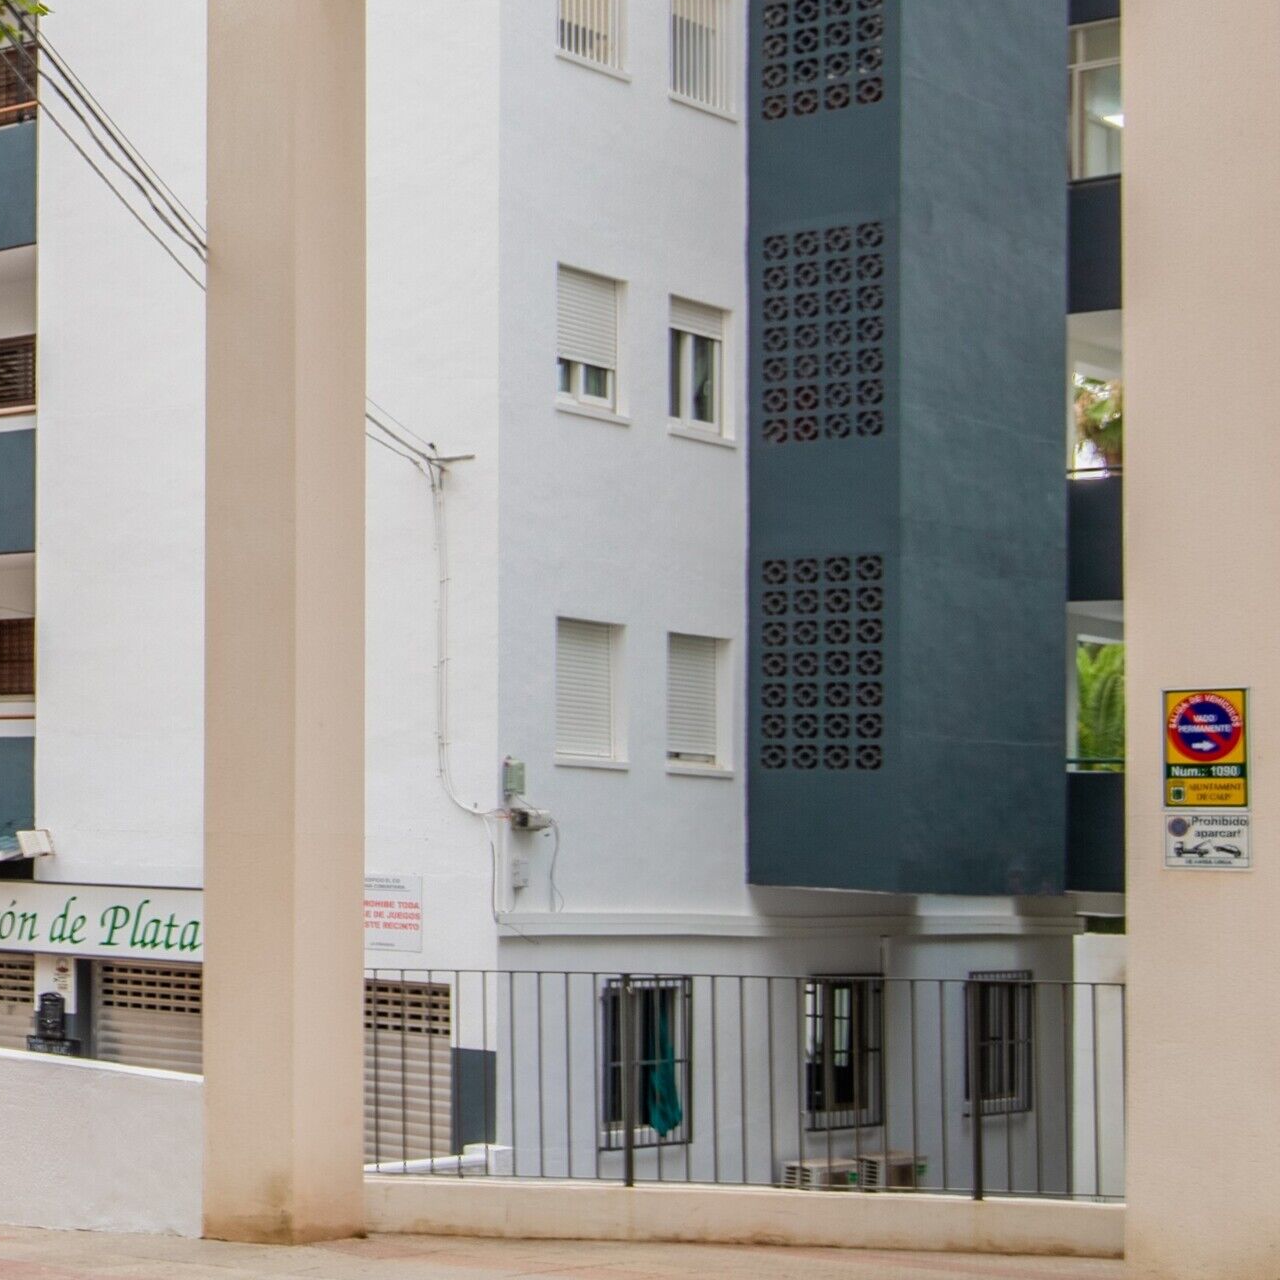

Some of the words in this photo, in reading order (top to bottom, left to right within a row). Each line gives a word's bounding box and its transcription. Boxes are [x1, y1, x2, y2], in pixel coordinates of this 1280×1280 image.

[1193, 714, 1215, 723] VADO
[1178, 724, 1232, 733] PERMANENTE
[363, 900, 396, 908] ROHIBE
[48, 896, 87, 944] de
[98, 899, 203, 952] Plata
